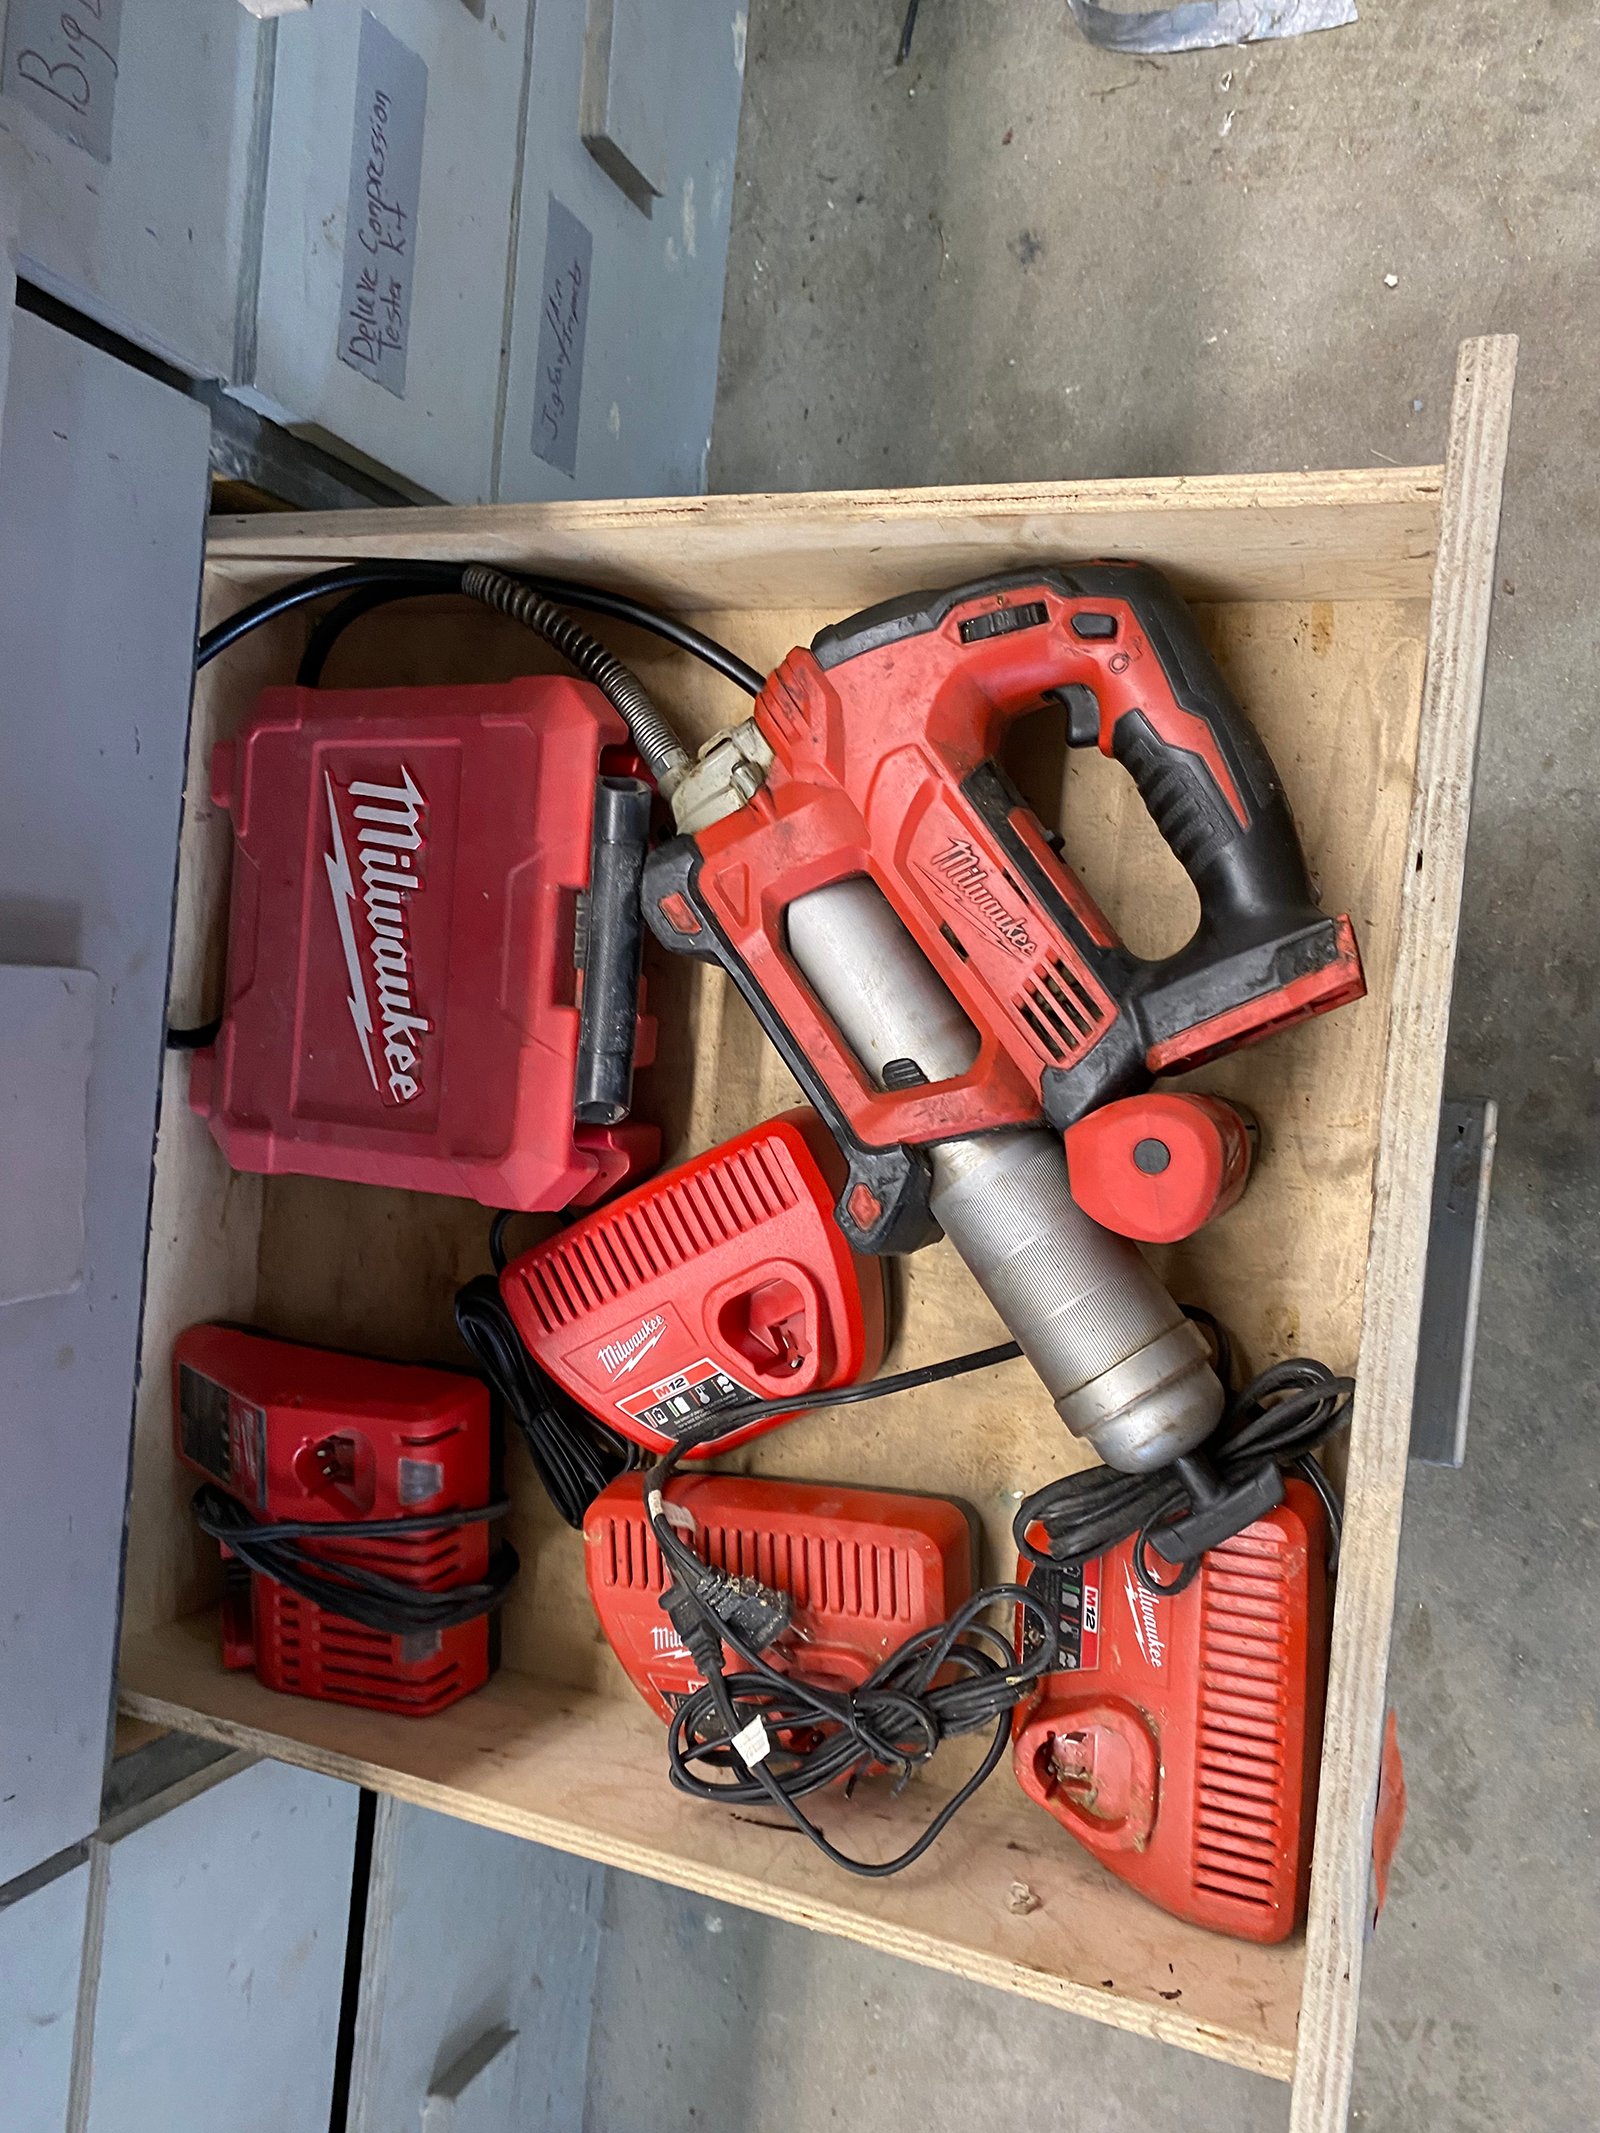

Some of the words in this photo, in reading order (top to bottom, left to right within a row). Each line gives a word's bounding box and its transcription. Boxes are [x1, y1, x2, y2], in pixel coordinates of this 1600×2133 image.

[17, 12, 118, 116] Big
[379, 202, 407, 256] Kit
[347, 268, 378, 365] Deluxe
[377, 277, 402, 361] Tester
[347, 766, 431, 1103] Milwaukee
[930, 838, 1038, 957] Milwaukee
[597, 1313, 665, 1374] Milwaukee
[655, 1377, 688, 1399] M12
[1086, 1589, 1097, 1630] M12
